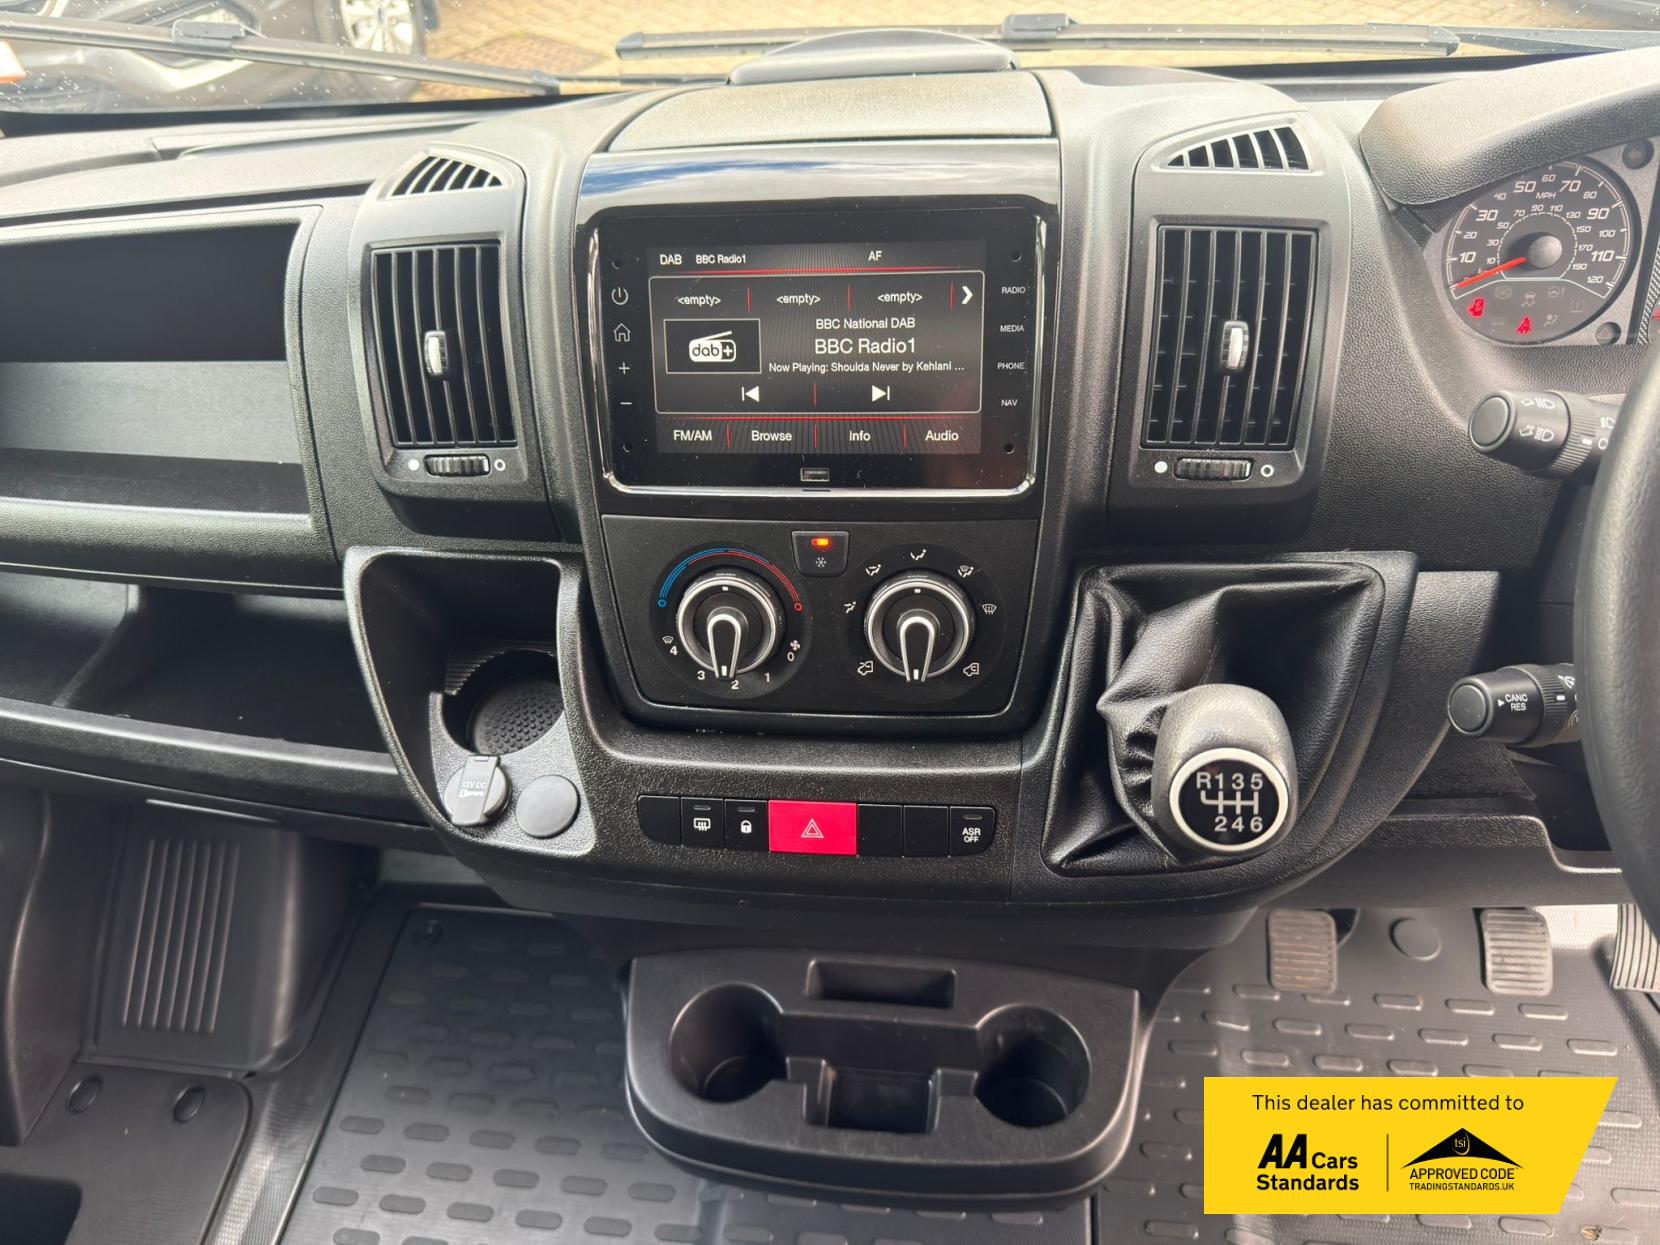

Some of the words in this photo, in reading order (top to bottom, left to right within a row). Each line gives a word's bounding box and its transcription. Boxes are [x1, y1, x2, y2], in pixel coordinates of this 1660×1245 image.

[1541, 174, 1556, 183] 60
[1513, 181, 1536, 193] 50
[1559, 180, 1581, 192] 70
[1493, 192, 1507, 201] 40
[1535, 192, 1556, 200] MPH
[1583, 191, 1597, 200] 80
[1476, 209, 1498, 221] 30
[1586, 208, 1609, 220] 90
[1463, 231, 1477, 239] 20
[1599, 229, 1616, 238] 100
[659, 254, 682, 266] DAB
[696, 254, 715, 265] BBC
[717, 253, 747, 264] Radio1
[868, 250, 882, 262] AF
[1459, 251, 1476, 263] 10
[1591, 250, 1614, 262] 110
[1587, 276, 1603, 284] 120
[1001, 286, 1026, 295] RADIO
[677, 294, 721, 308] <empty>
[776, 293, 821, 307] <empty>
[877, 292, 923, 306] <empty>
[815, 318, 841, 330] BBC
[844, 317, 888, 330] National
[891, 317, 915, 329] DAB
[1000, 325, 1025, 333] MEDIA
[814, 339, 853, 355] BBC
[858, 338, 916, 354] Radio1
[768, 362, 790, 374] Now
[792, 362, 829, 375] Playing:
[831, 361, 869, 373] Shoulda
[871, 362, 900, 373] Never
[902, 361, 914, 375] by
[916, 360, 952, 372] Kehlani
[997, 362, 1025, 371] PHONE
[1001, 399, 1018, 407] NAV
[673, 430, 712, 442] FM/AM
[751, 430, 792, 442] Browse
[848, 430, 871, 442] Info
[925, 430, 959, 442] Audio
[669, 645, 678, 656] 4
[697, 670, 706, 681] 3
[764, 672, 771, 683] 1
[730, 679, 740, 690] 2
[1505, 694, 1528, 702] CANC
[1511, 703, 1526, 711] RES
[961, 827, 982, 836] ASR
[963, 835, 979, 843] OFF
